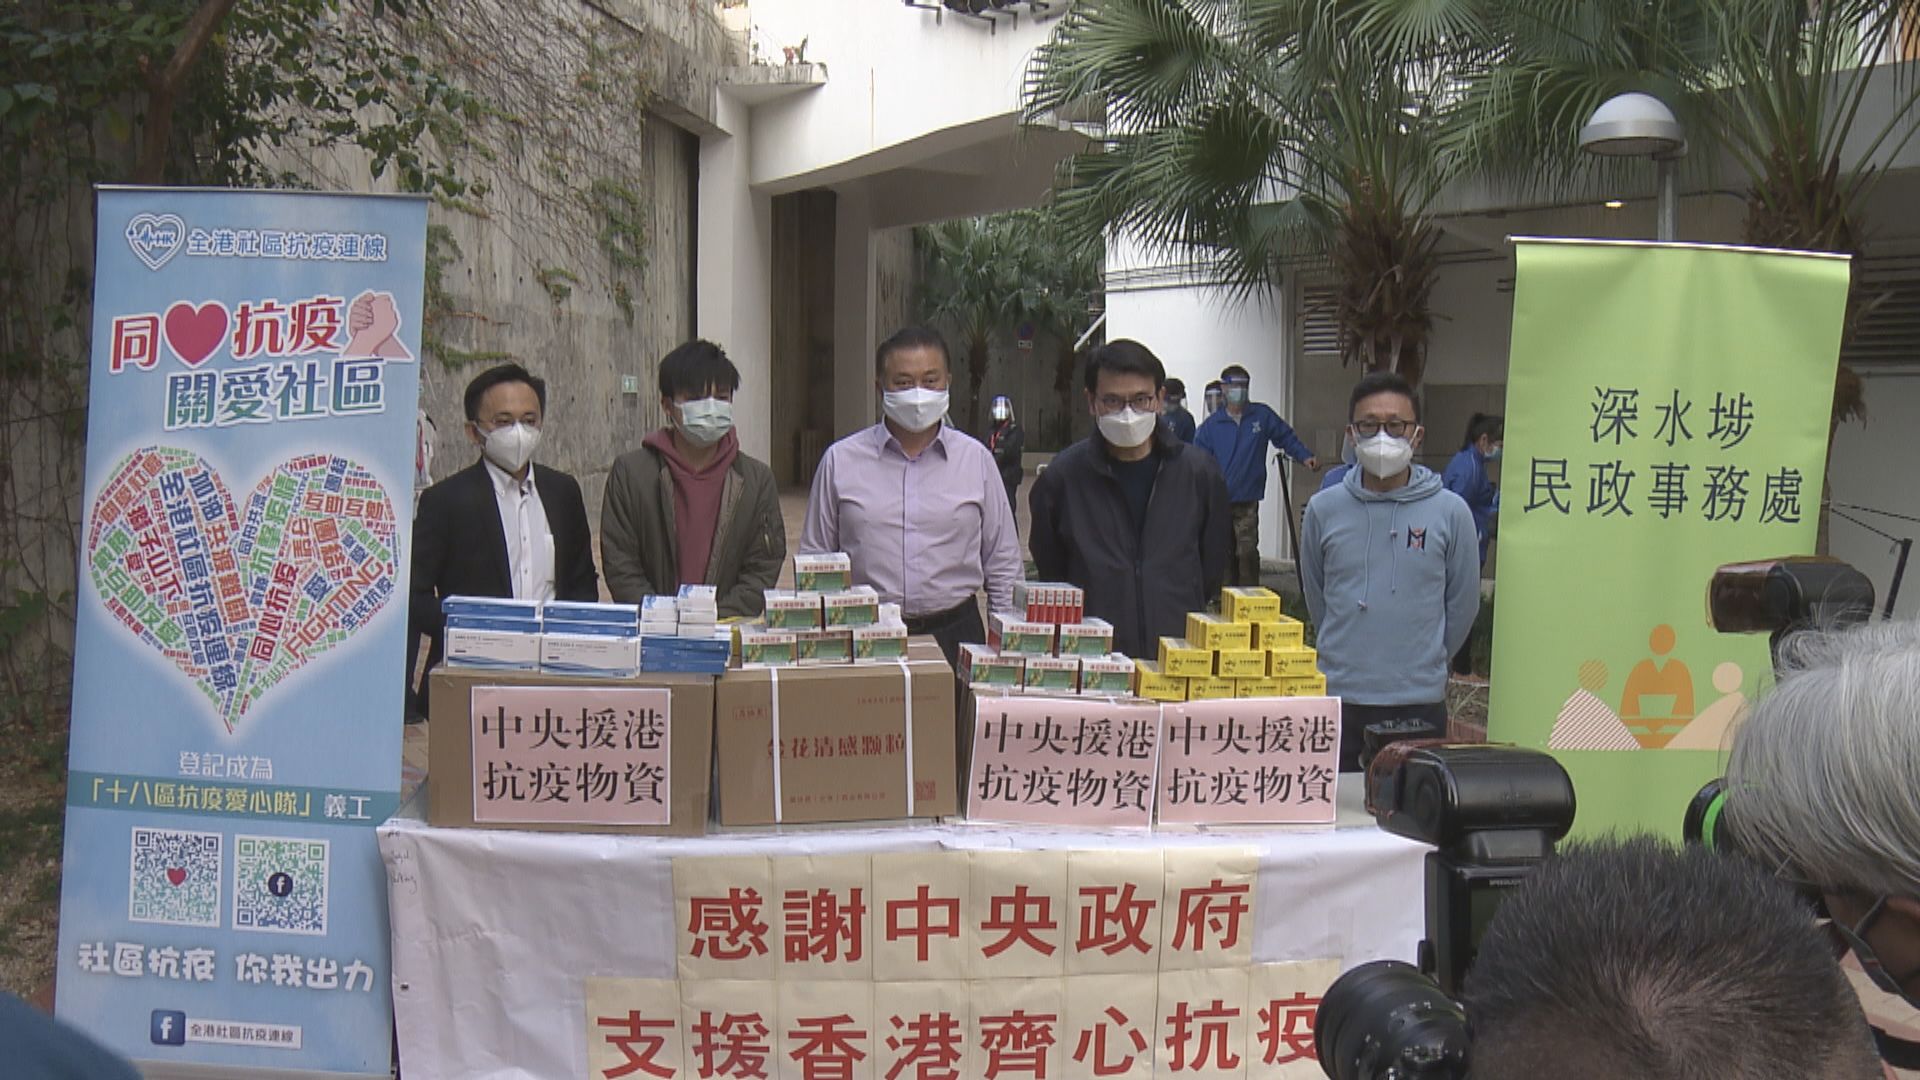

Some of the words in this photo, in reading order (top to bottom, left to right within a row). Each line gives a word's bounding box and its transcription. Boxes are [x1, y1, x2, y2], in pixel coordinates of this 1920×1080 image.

[155, 232, 174, 246] HK
[188, 228, 387, 262] 全港社區抗疫連線
[232, 296, 344, 357] 抗疫
[165, 358, 384, 430] 關愛社區
[1590, 385, 1755, 450] 深水埗
[189, 470, 223, 521] 加油
[1523, 456, 1804, 525] 民政事務處
[128, 504, 183, 601] 獅子山下
[205, 524, 250, 622] 共渡難關
[160, 472, 237, 692] 全港社區抗疫連線
[284, 556, 384, 659] FIGHTING
[250, 562, 299, 662] 同心抗疫
[482, 706, 665, 749] 中央援港
[984, 713, 1155, 760] 中央援港
[1169, 715, 1335, 757] 中央援港
[179, 752, 273, 780] 登記成為
[483, 761, 665, 805] 抗疫物資
[978, 764, 1151, 812] 抗疫物資
[1168, 764, 1332, 806] 抗疫物資
[688, 880, 1250, 963] 感謝中央政府
[78, 942, 215, 981] 社區抗疫
[236, 953, 373, 992] 你我出力
[190, 1023, 294, 1043] 全港社區抗疫連線
[598, 992, 1321, 1080] 支援香港齊心抗疫
